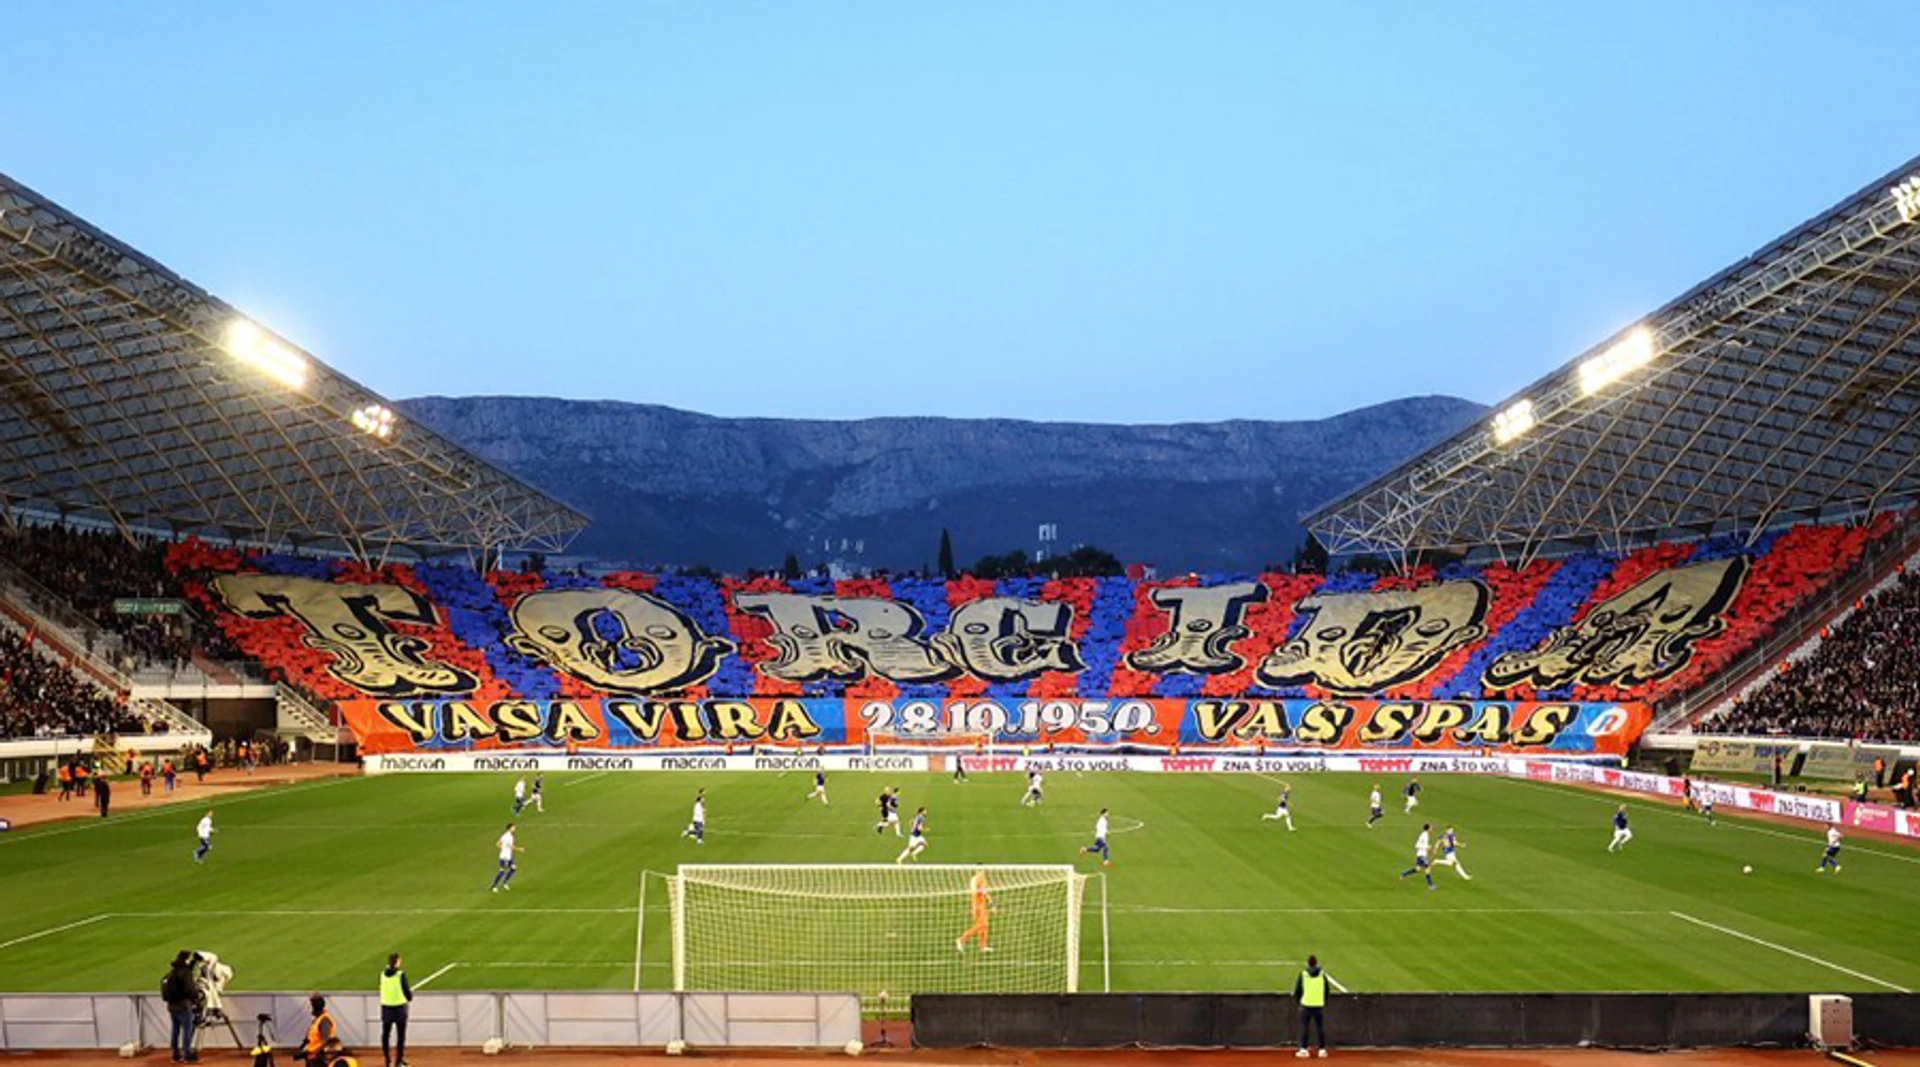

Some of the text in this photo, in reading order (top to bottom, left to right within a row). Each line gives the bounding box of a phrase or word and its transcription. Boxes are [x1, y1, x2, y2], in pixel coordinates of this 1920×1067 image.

[607, 699, 822, 741] VIRA
[1357, 700, 1580, 745] SPAS
[380, 756, 445, 769] macron
[473, 756, 538, 769] macron
[567, 756, 632, 769] macron
[661, 756, 726, 769] macron
[755, 756, 820, 769] macron
[1024, 760, 1053, 771] ZNA
[1057, 757, 1085, 771] ŠTO
[1161, 758, 1216, 771] TOMMY
[1222, 760, 1250, 771] ZNA
[1255, 758, 1282, 771] ŠTO
[1358, 759, 1413, 771] TOMMY
[1419, 761, 1447, 771] ZNA
[1452, 758, 1477, 771] ŠTO
